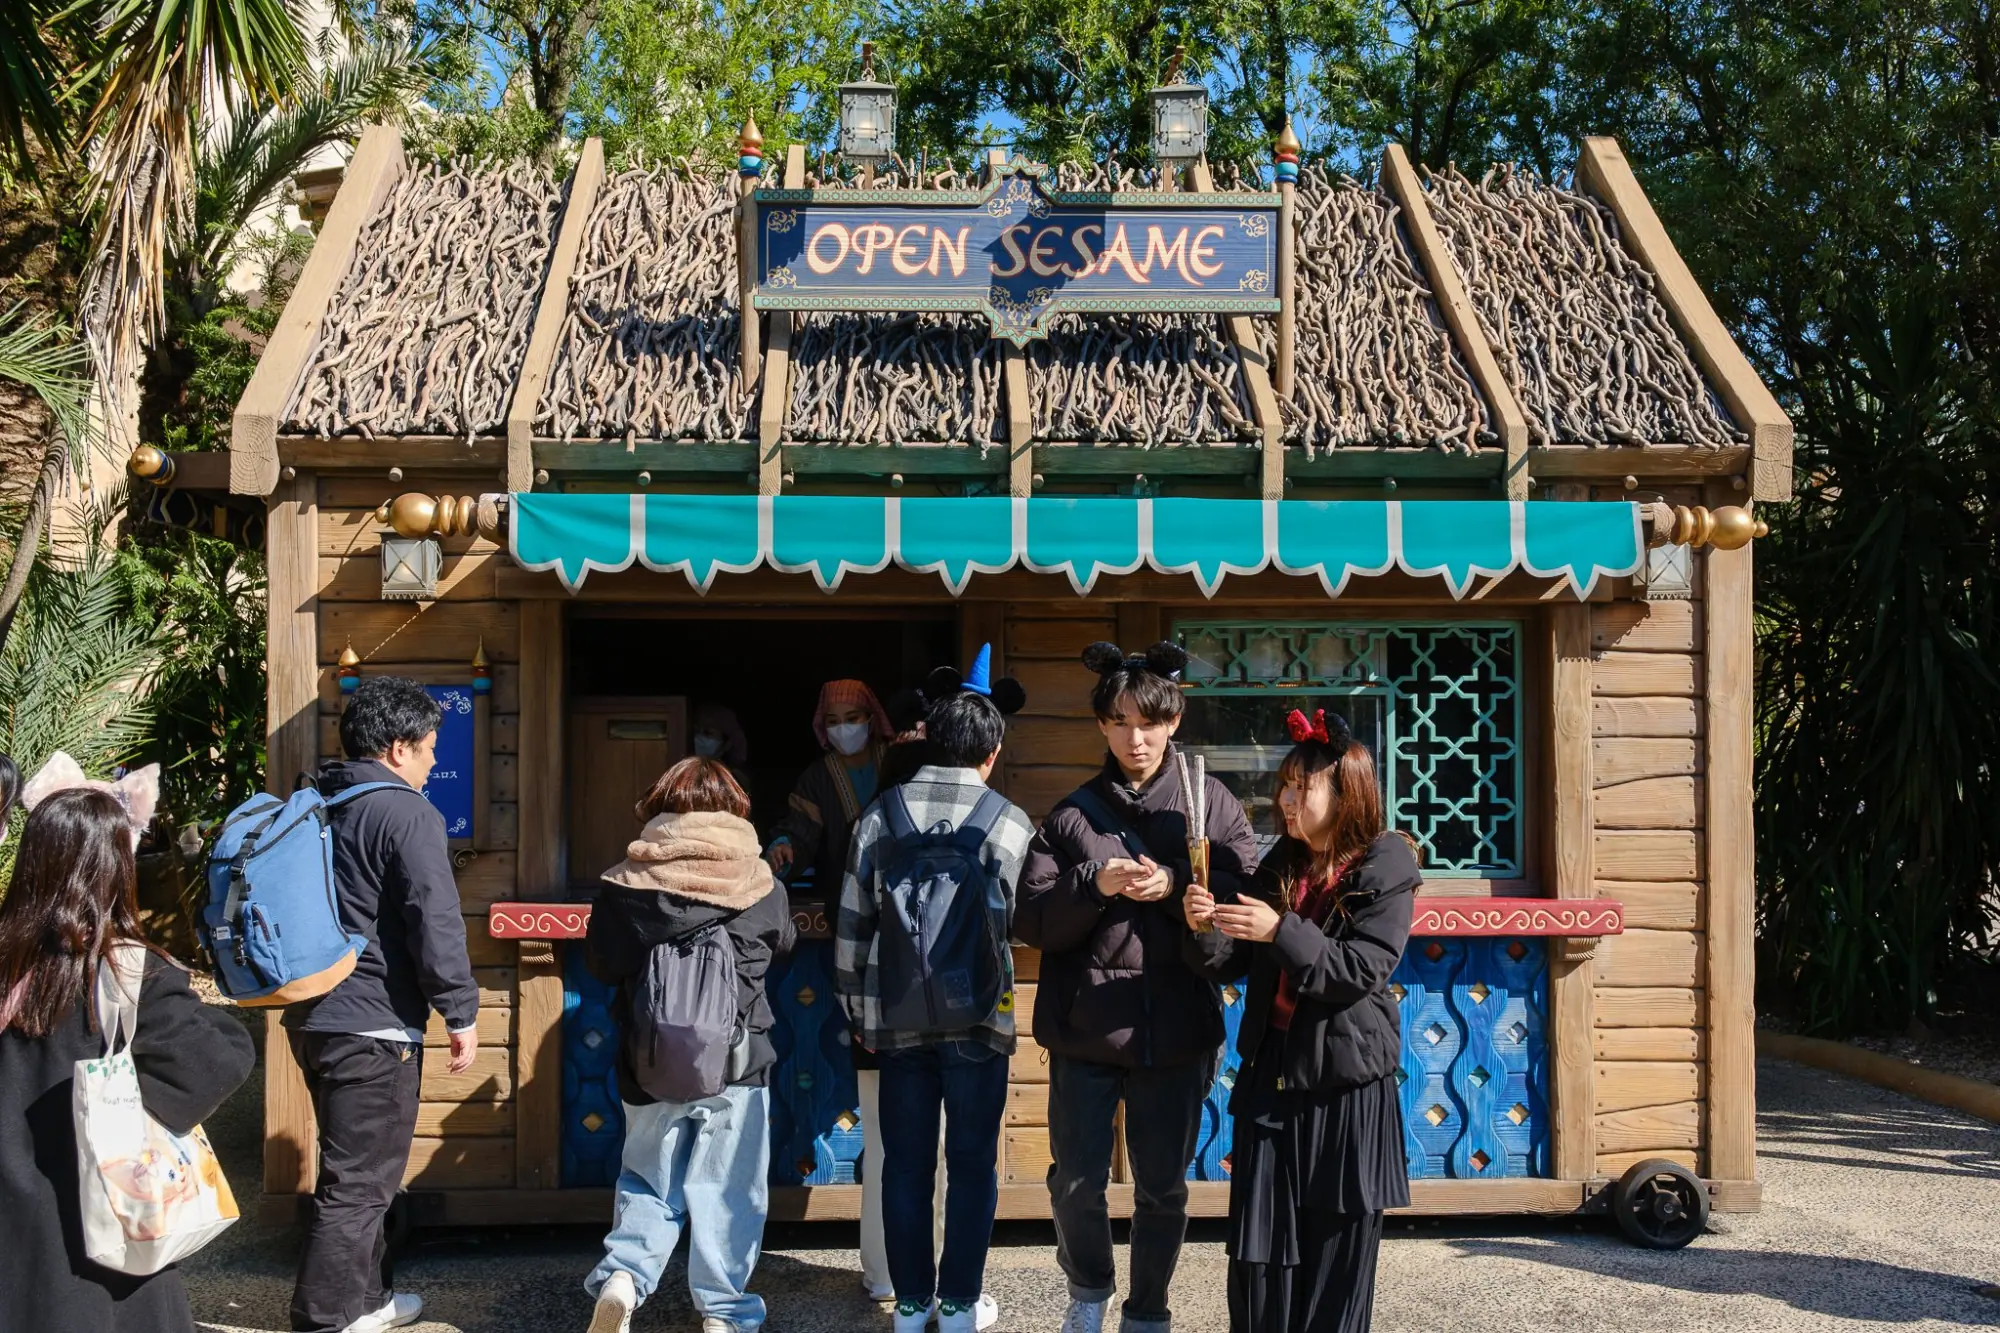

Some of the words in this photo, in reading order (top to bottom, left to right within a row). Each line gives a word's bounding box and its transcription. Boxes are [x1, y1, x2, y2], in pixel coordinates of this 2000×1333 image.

[806, 221, 971, 277] OPEN
[989, 222, 1225, 286] SESAME
[429, 770, 458, 779] ュロス
